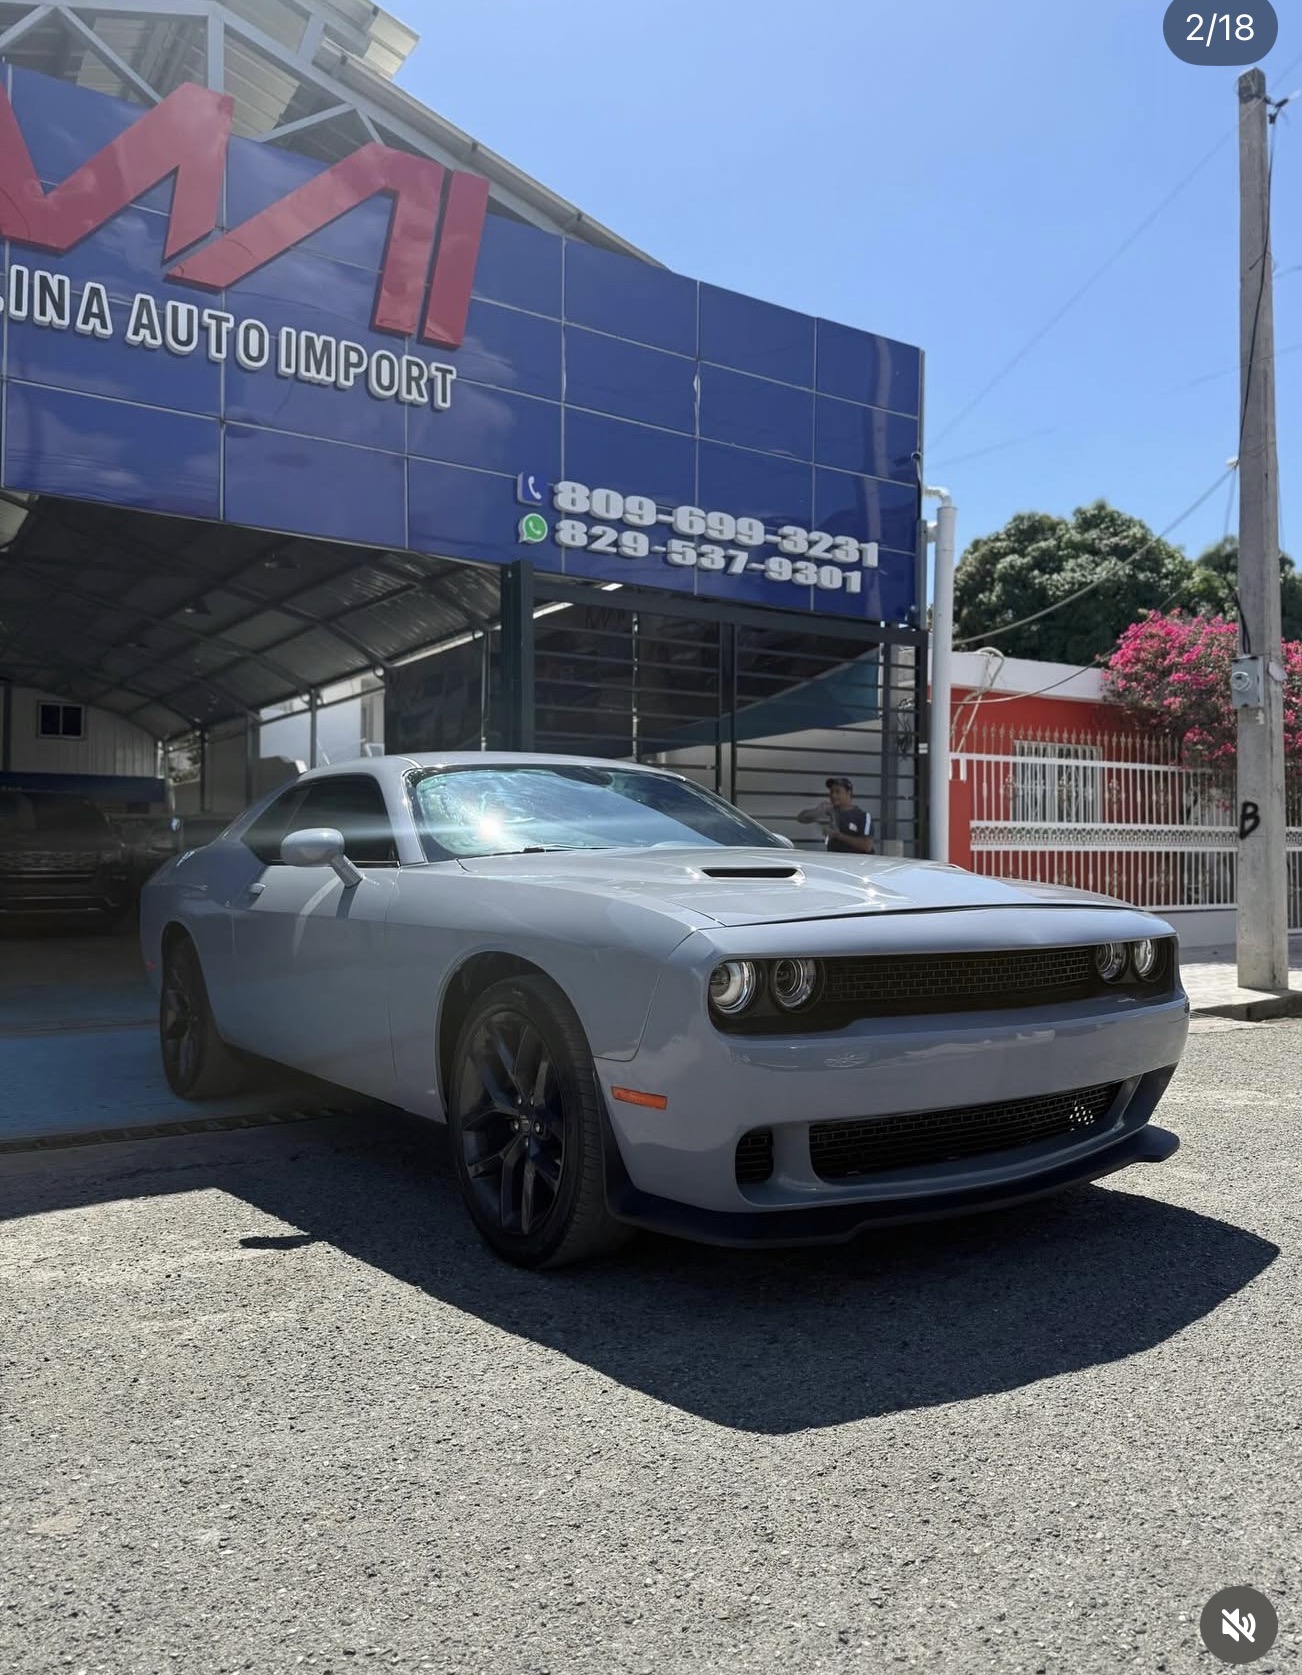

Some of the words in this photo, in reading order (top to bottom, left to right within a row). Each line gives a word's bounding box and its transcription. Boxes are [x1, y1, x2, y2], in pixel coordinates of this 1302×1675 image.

[0, 265, 113, 337] INA
[126, 293, 267, 369] AUTO
[279, 327, 458, 411] IMPORT
[554, 481, 879, 568] 809-699-3231
[554, 519, 863, 594] 829-537-9301
[1240, 801, 1261, 840] B
